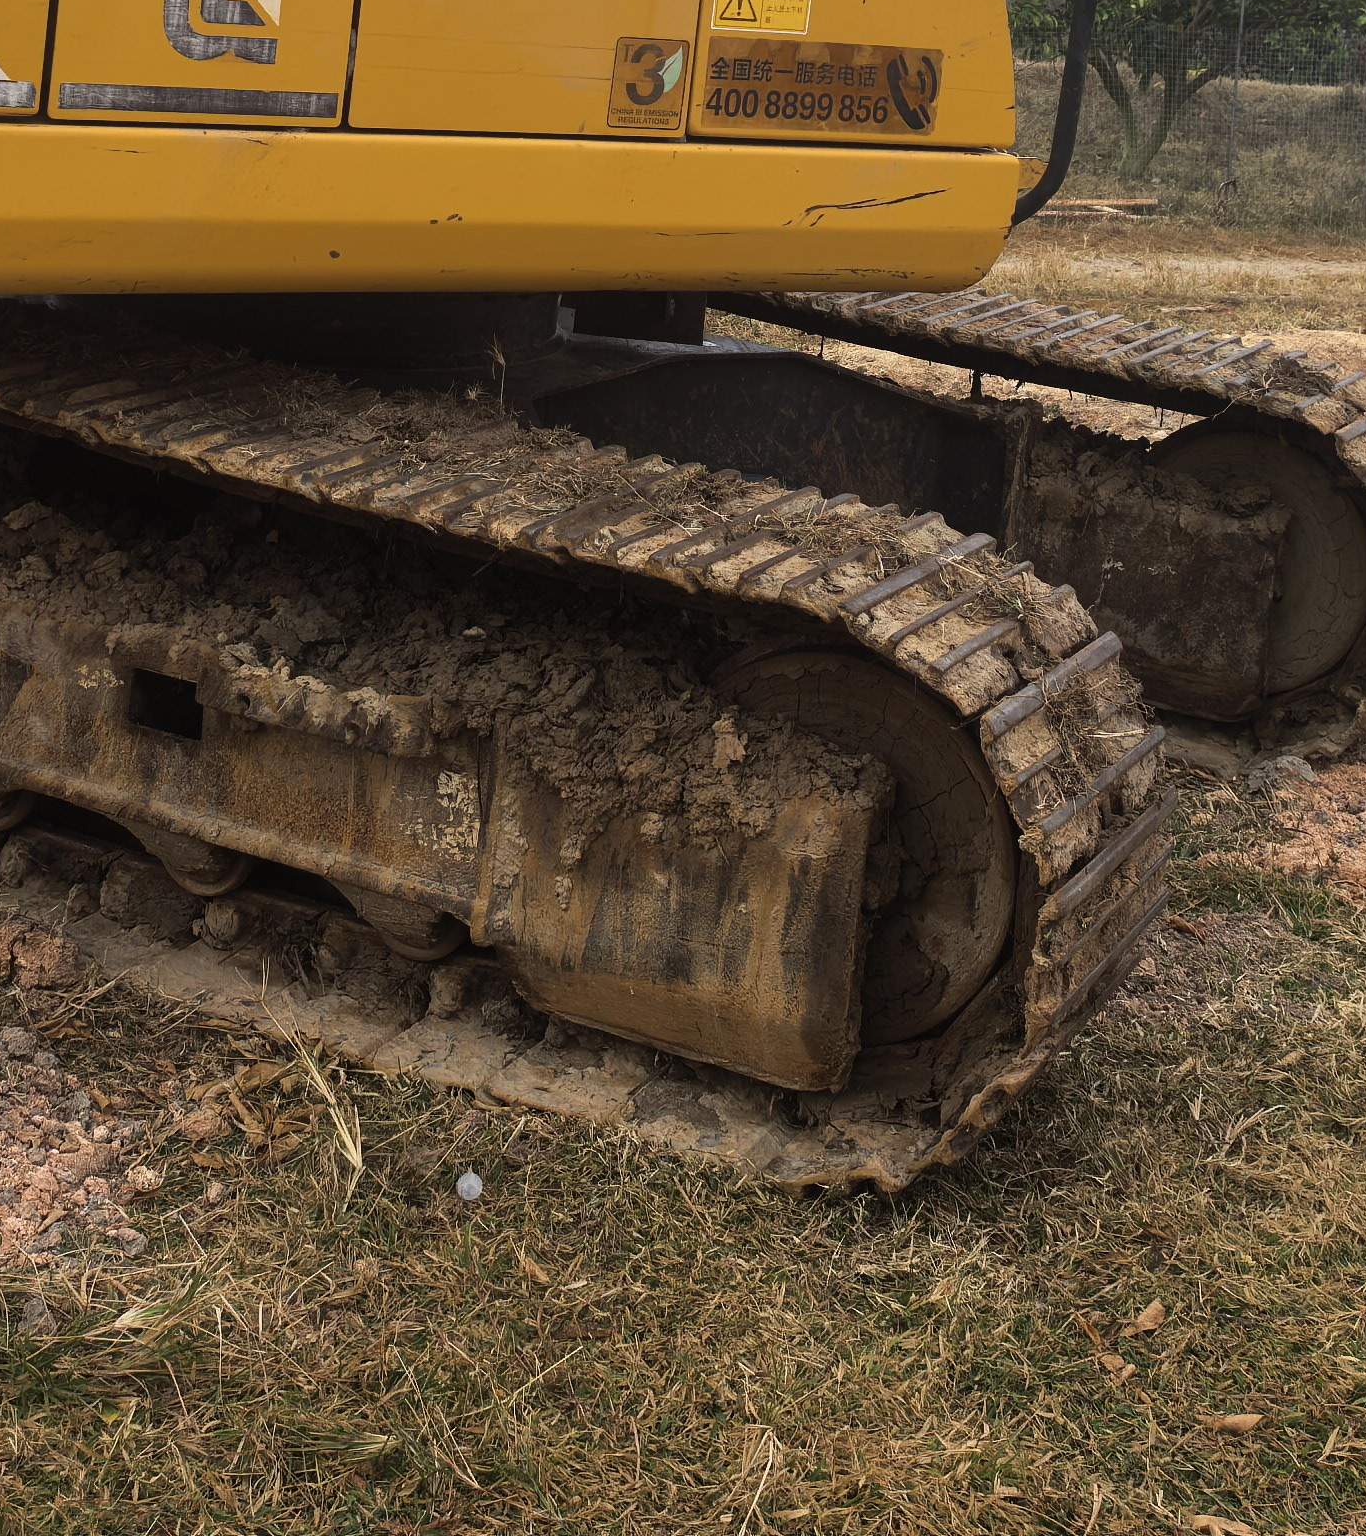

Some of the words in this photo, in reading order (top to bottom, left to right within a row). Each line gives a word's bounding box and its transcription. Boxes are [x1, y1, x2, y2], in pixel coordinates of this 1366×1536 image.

[710, 56, 878, 88] 全国统一服务电话
[705, 87, 759, 119] 400
[763, 90, 834, 122] 8899
[837, 94, 889, 124] 856
